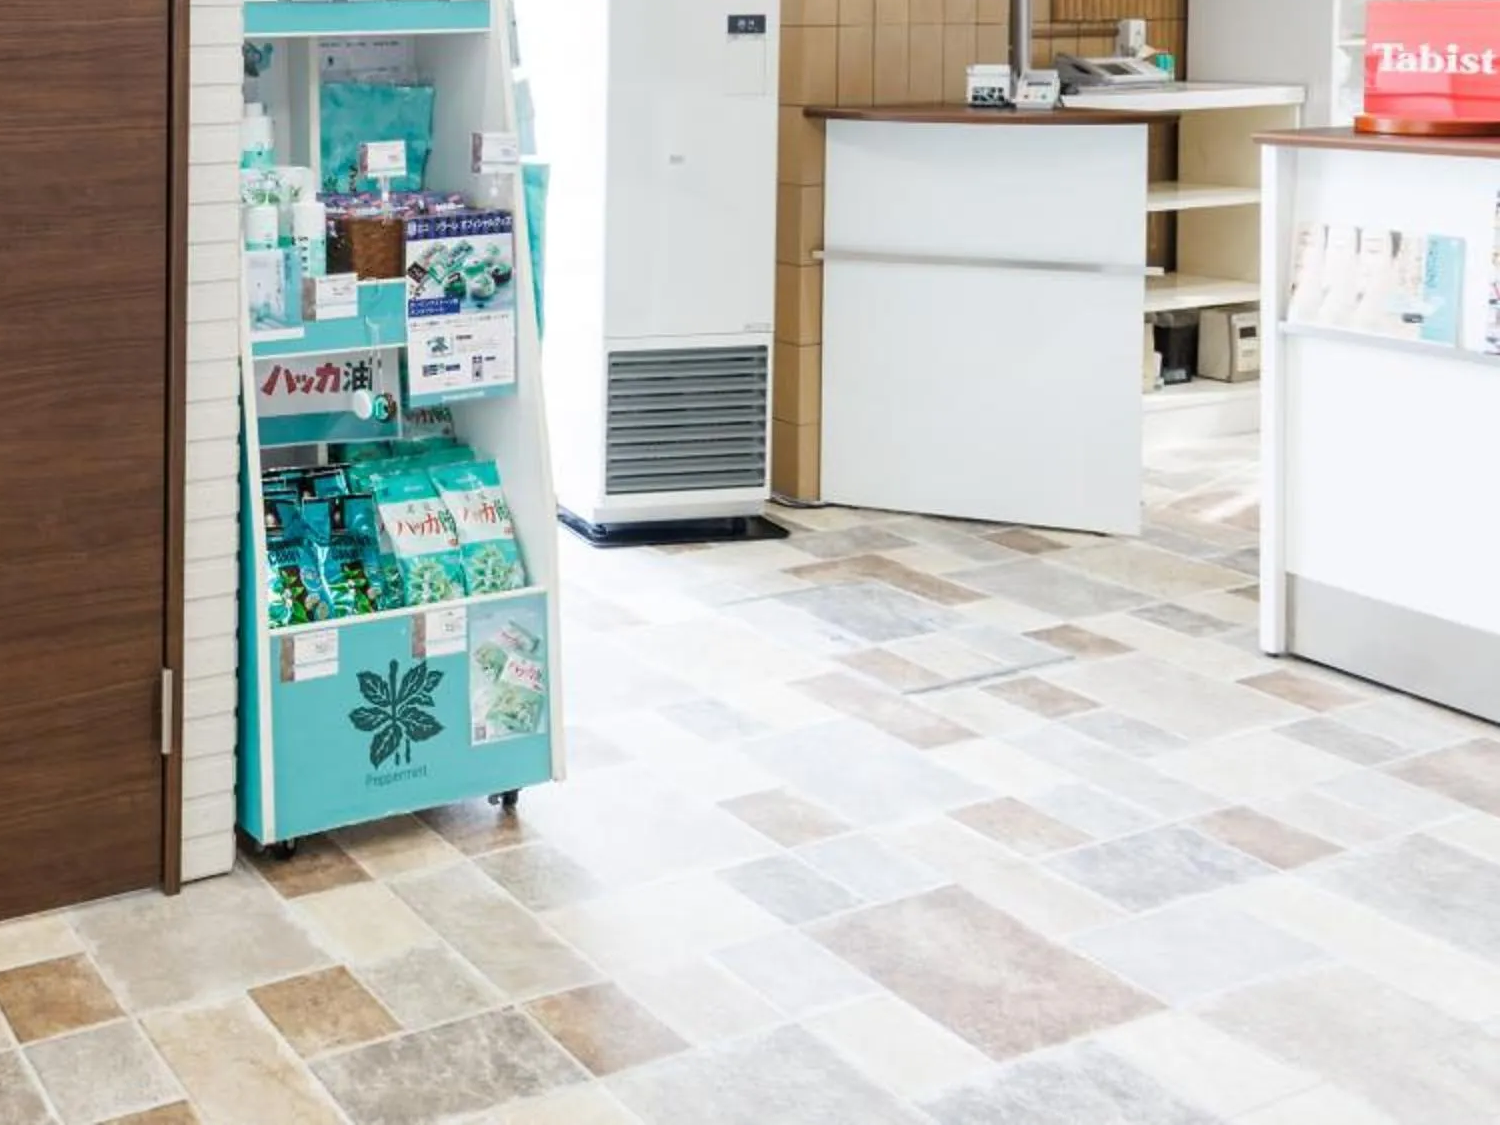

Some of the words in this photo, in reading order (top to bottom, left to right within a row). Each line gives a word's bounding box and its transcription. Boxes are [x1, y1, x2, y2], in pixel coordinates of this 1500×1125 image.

[1371, 42, 1497, 75] Tabist
[261, 359, 373, 397] ハッカ油
